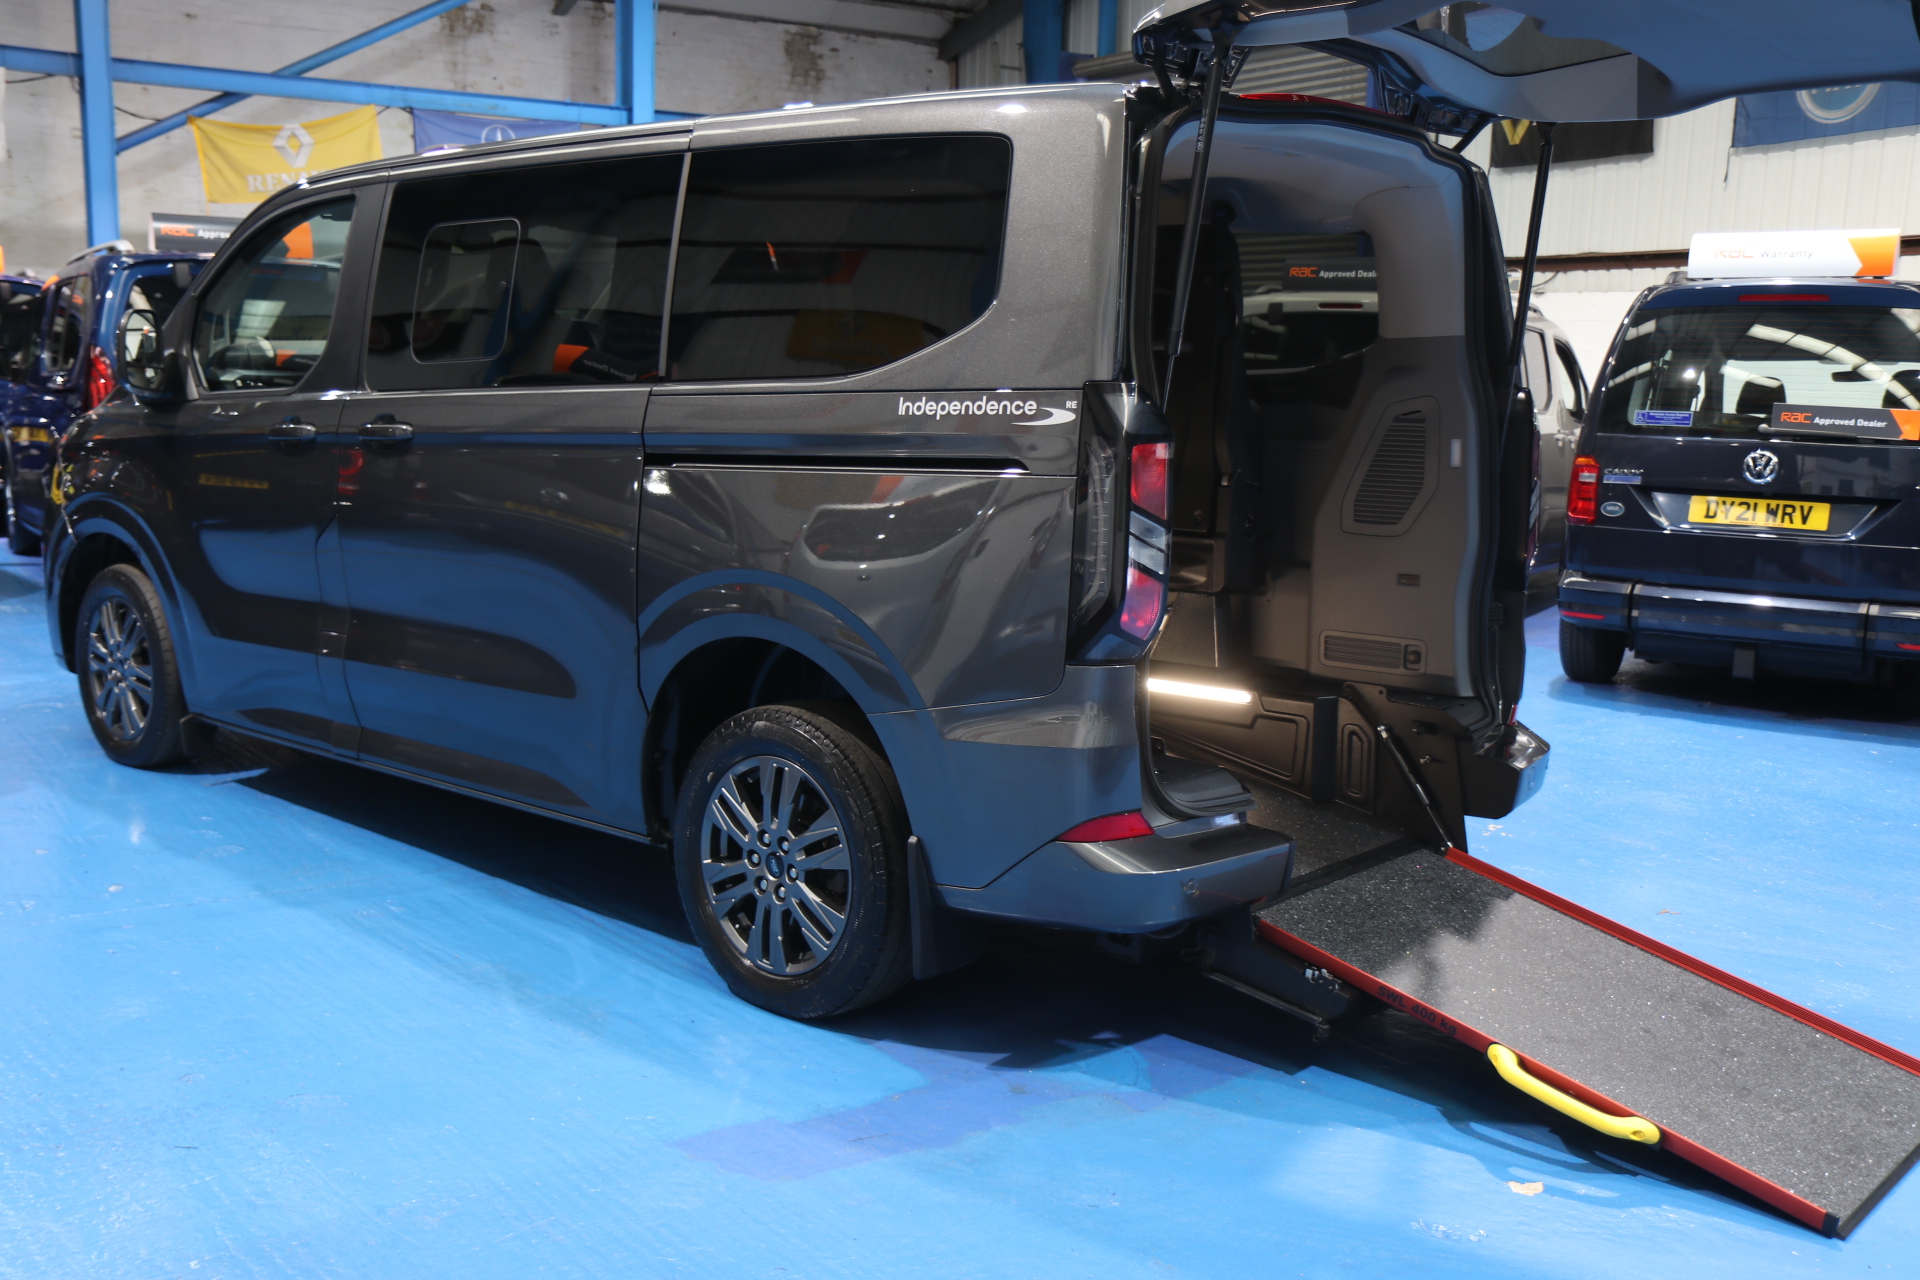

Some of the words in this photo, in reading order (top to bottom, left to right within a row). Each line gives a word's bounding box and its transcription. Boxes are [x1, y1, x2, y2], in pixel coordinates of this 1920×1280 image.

[247, 170, 318, 193] RENA
[1760, 250, 1813, 259] Warranty
[1319, 270, 1356, 279] Approved
[1357, 270, 1377, 278] Deal
[898, 395, 1037, 420] Independence
[1065, 401, 1077, 409] RE
[1813, 417, 1855, 427] Approved
[1857, 419, 1888, 428] Dealer
[1704, 500, 1758, 522] DY21
[1765, 503, 1813, 526] WRV
[1378, 986, 1406, 1008] SWL
[1411, 1004, 1437, 1023] 400
[1440, 1018, 1458, 1036] kg
